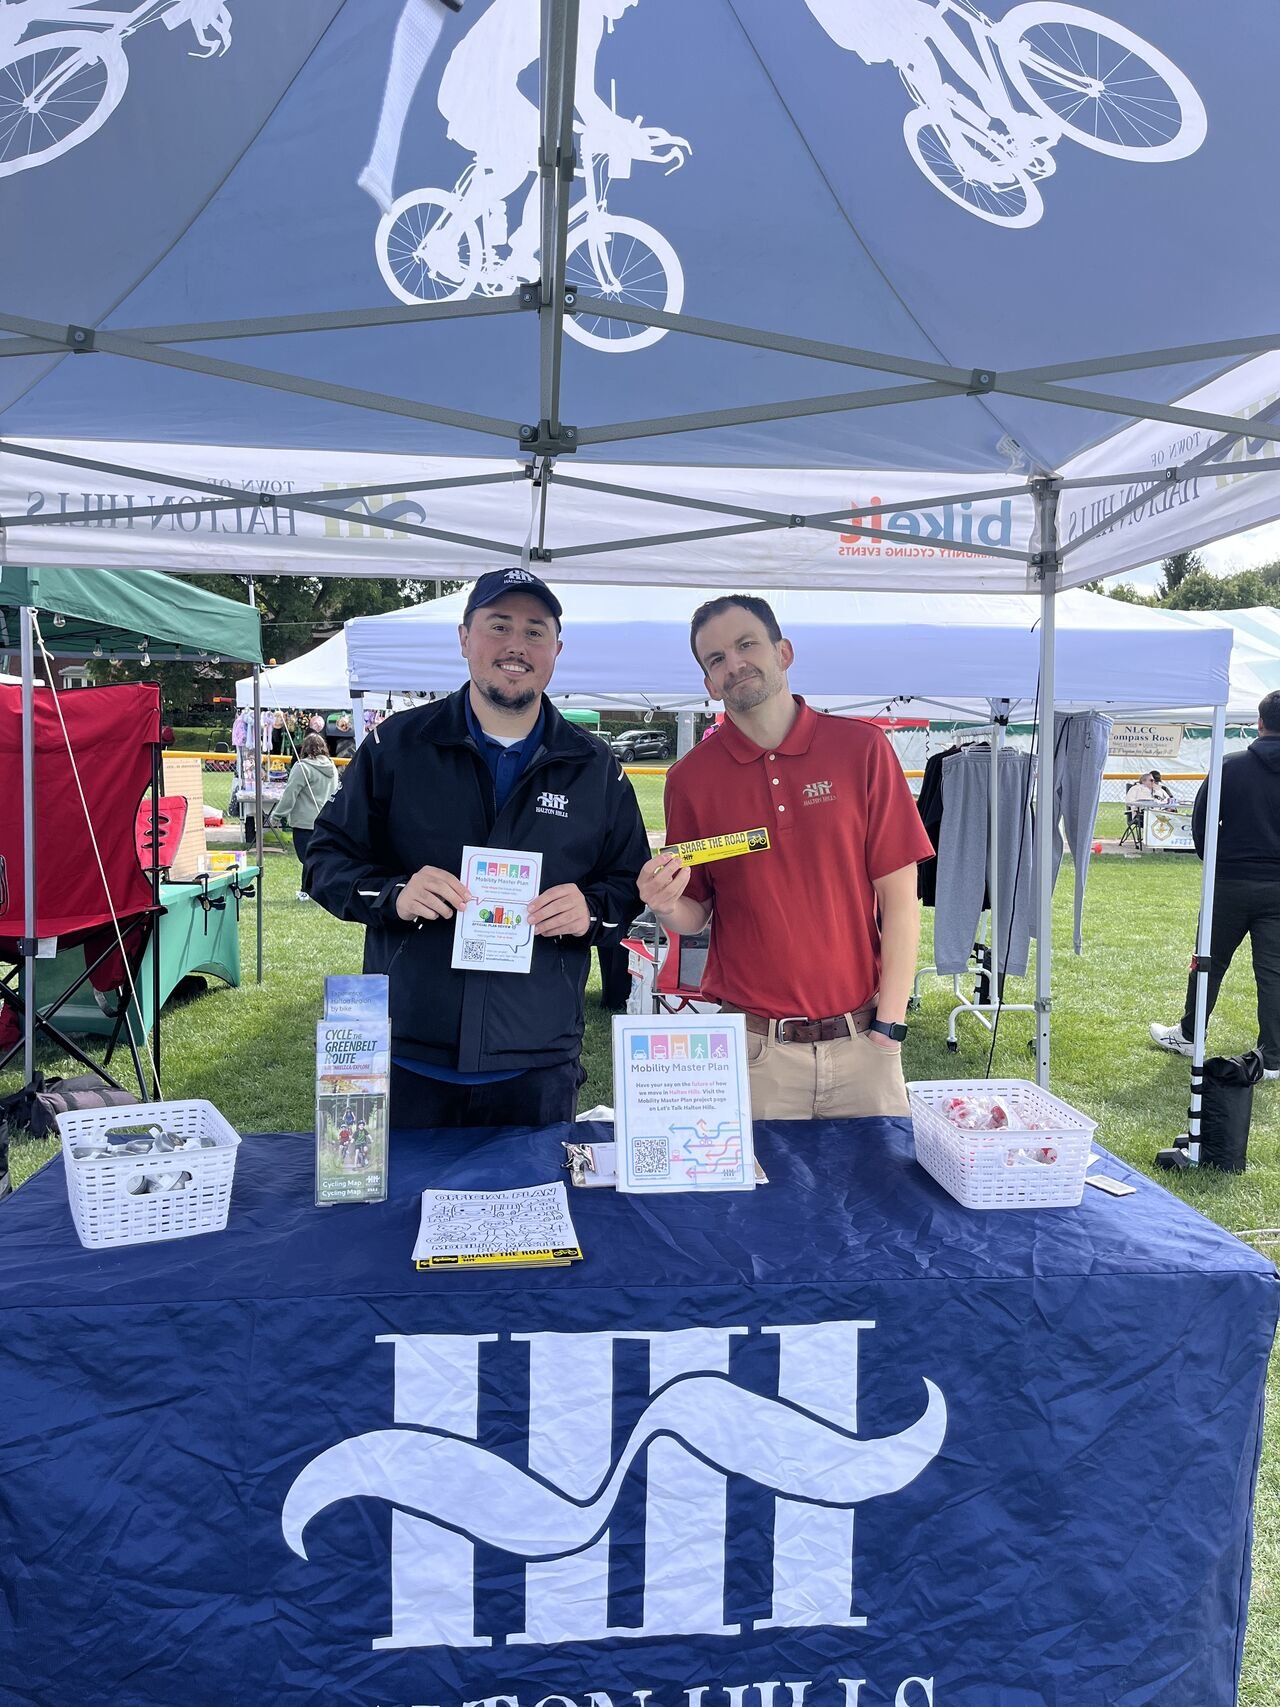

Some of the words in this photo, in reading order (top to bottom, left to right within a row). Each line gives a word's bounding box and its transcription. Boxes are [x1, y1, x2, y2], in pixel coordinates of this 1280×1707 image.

[1125, 726, 1157, 734] NLCC
[1111, 734, 1149, 742] ompass
[1152, 734, 1174, 742] Rose
[803, 797, 822, 806] HALTON
[822, 795, 837, 803] HILLS
[535, 806, 555, 815] HALTON
[555, 810, 568, 818] HILLS
[680, 841, 707, 854] SHARE
[708, 837, 724, 848] THE
[724, 832, 746, 846] ROAD
[475, 876, 497, 884] Mobility
[325, 1029, 353, 1041] CYCLE
[325, 1040, 378, 1052] GREENBELT
[325, 1053, 357, 1065] ROUTE
[631, 1064, 671, 1074] Mobility
[672, 1063, 706, 1072] Master
[708, 1062, 729, 1071] Plan
[322, 1180, 347, 1188] Cycling
[321, 1190, 346, 1198] Cycling
[512, 1188, 557, 1199] PLAN
